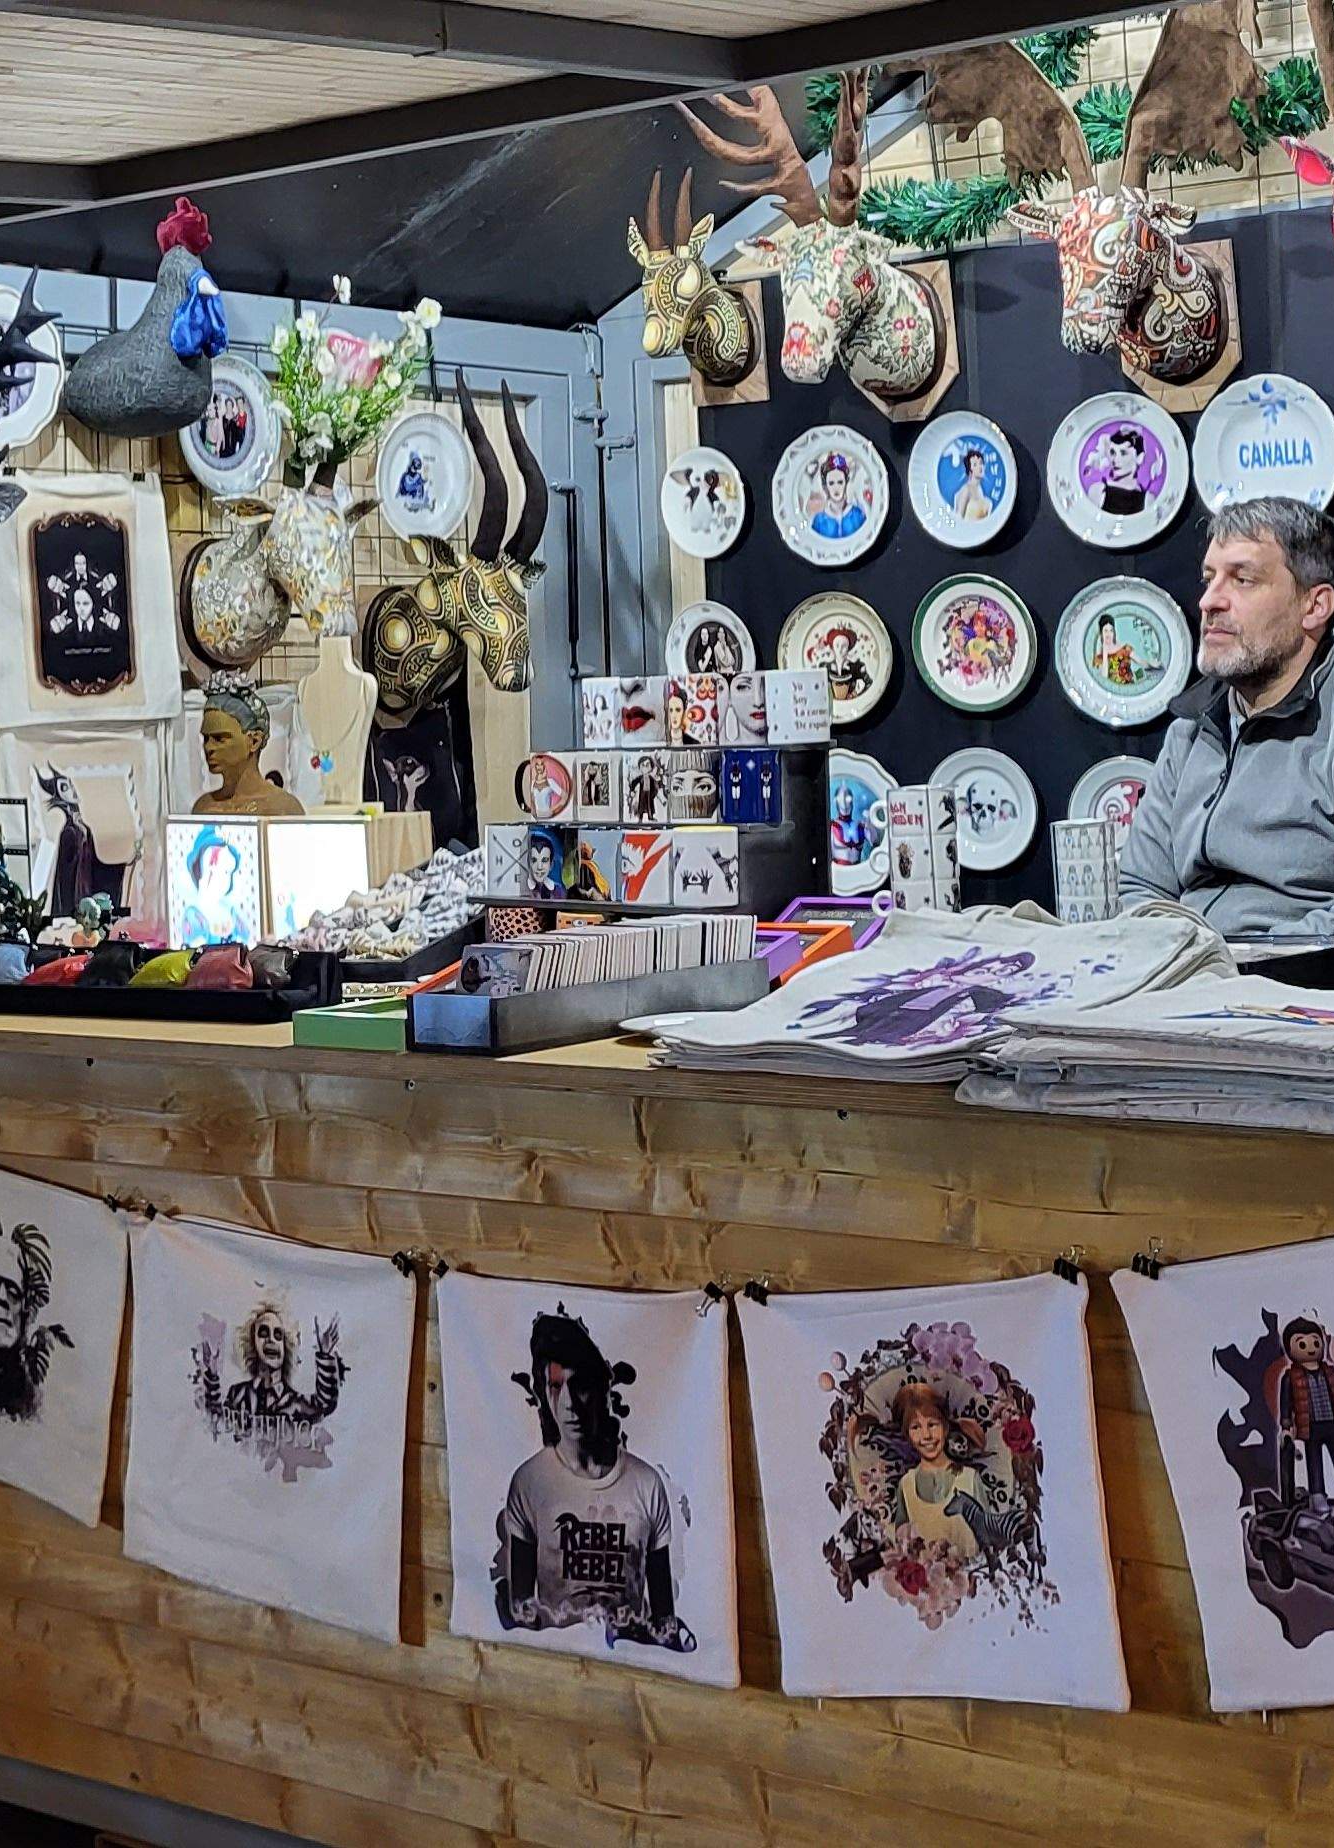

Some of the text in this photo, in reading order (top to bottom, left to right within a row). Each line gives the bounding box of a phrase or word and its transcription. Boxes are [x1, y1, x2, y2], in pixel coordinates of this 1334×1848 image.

[1239, 437, 1313, 469] CANALLA
[553, 1512, 629, 1553] REBEL
[562, 1549, 627, 1584] REBEL
